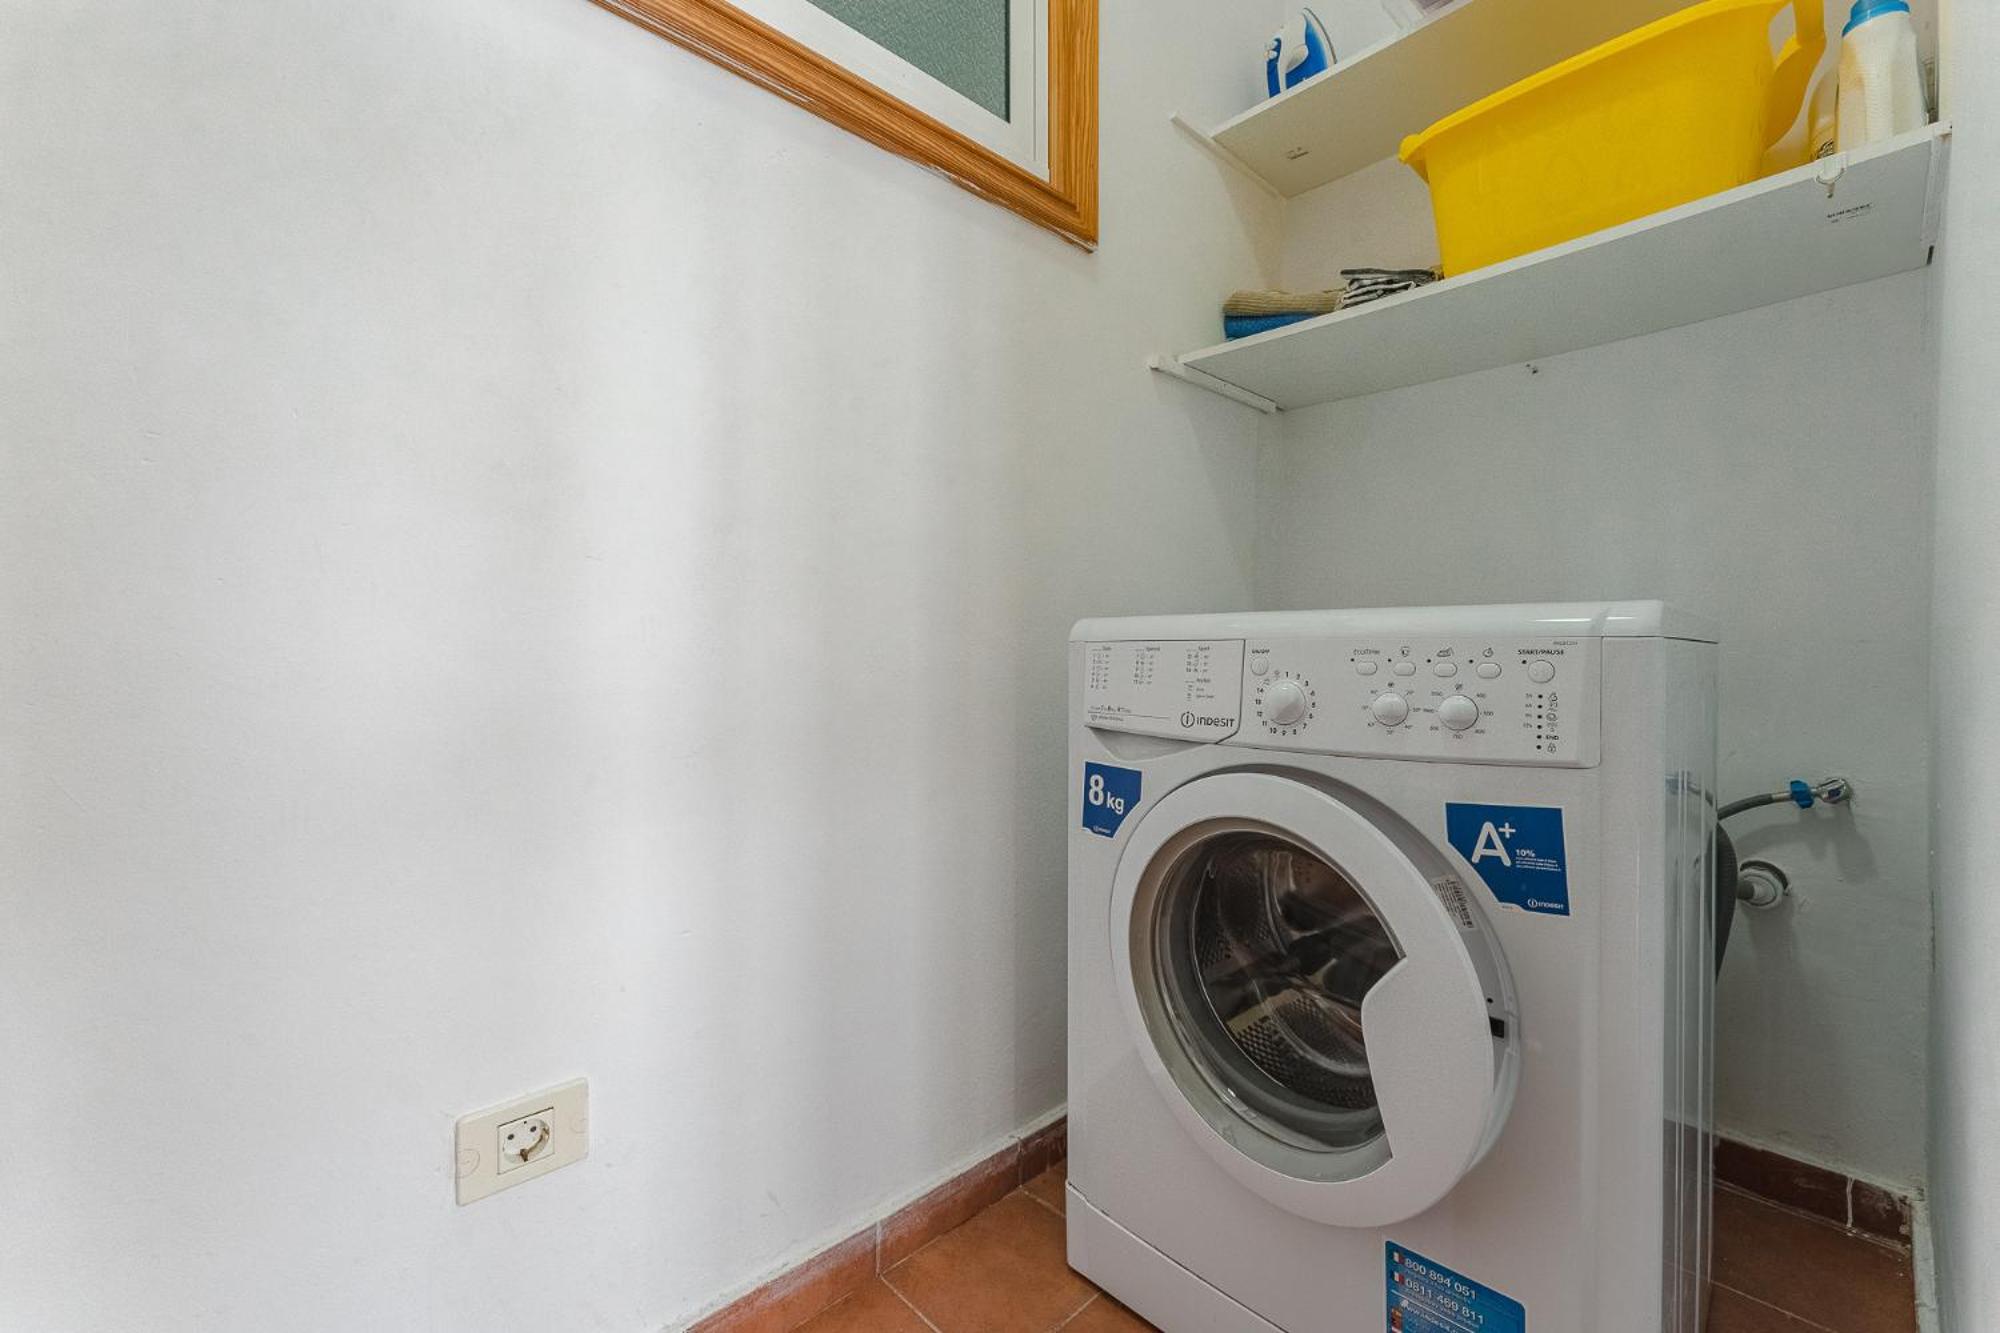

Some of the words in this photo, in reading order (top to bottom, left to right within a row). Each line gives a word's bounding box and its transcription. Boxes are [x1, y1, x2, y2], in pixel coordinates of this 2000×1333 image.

[1088, 774, 1105, 806] 8
[1107, 791, 1125, 815] kg
[1516, 849, 1536, 858] 10%
[1404, 1257, 1427, 1275] 800
[1429, 1270, 1452, 1287] 894
[1454, 1282, 1477, 1300] 051
[1405, 1278, 1433, 1299] 0811
[1462, 1306, 1484, 1325] 811
